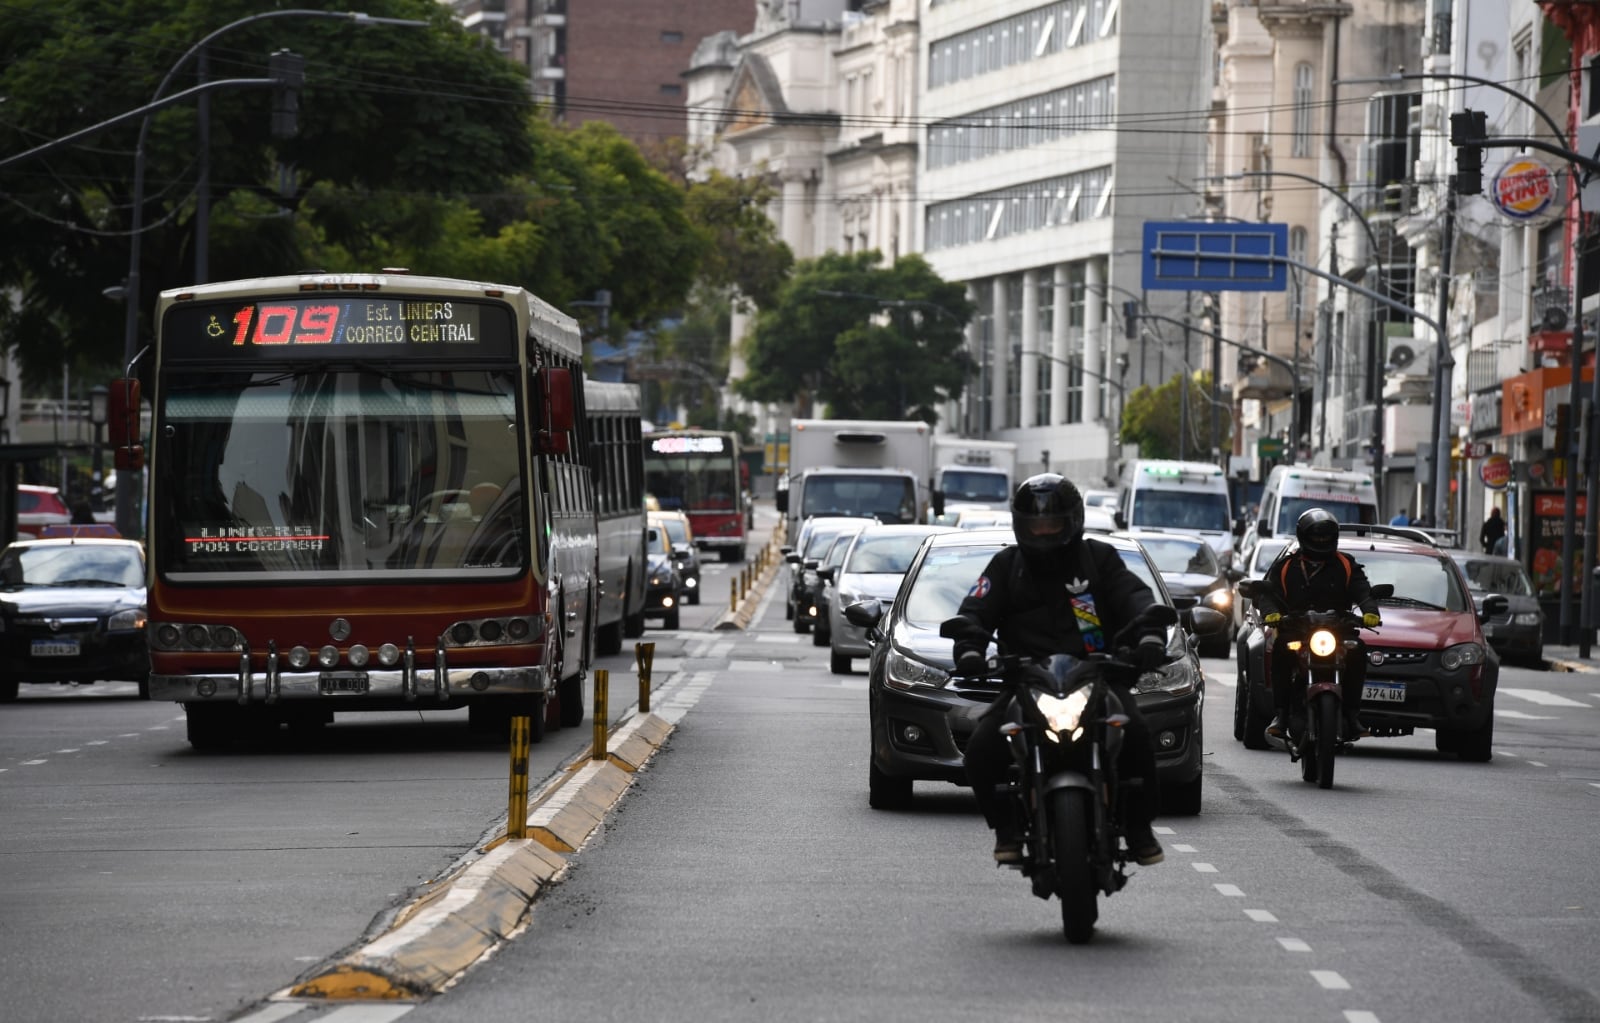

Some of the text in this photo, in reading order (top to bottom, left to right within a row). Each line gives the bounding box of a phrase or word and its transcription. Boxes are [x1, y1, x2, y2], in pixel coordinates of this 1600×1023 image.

[1501, 178, 1550, 207] KING
[367, 302, 453, 321] Est. LINIERS
[233, 305, 340, 345] 109
[346, 324, 475, 342] CORREO CENTRAL
[201, 525, 312, 538] LINIERS
[192, 539, 323, 552] POR CORDOBA
[1366, 688, 1403, 701] 374 UX
